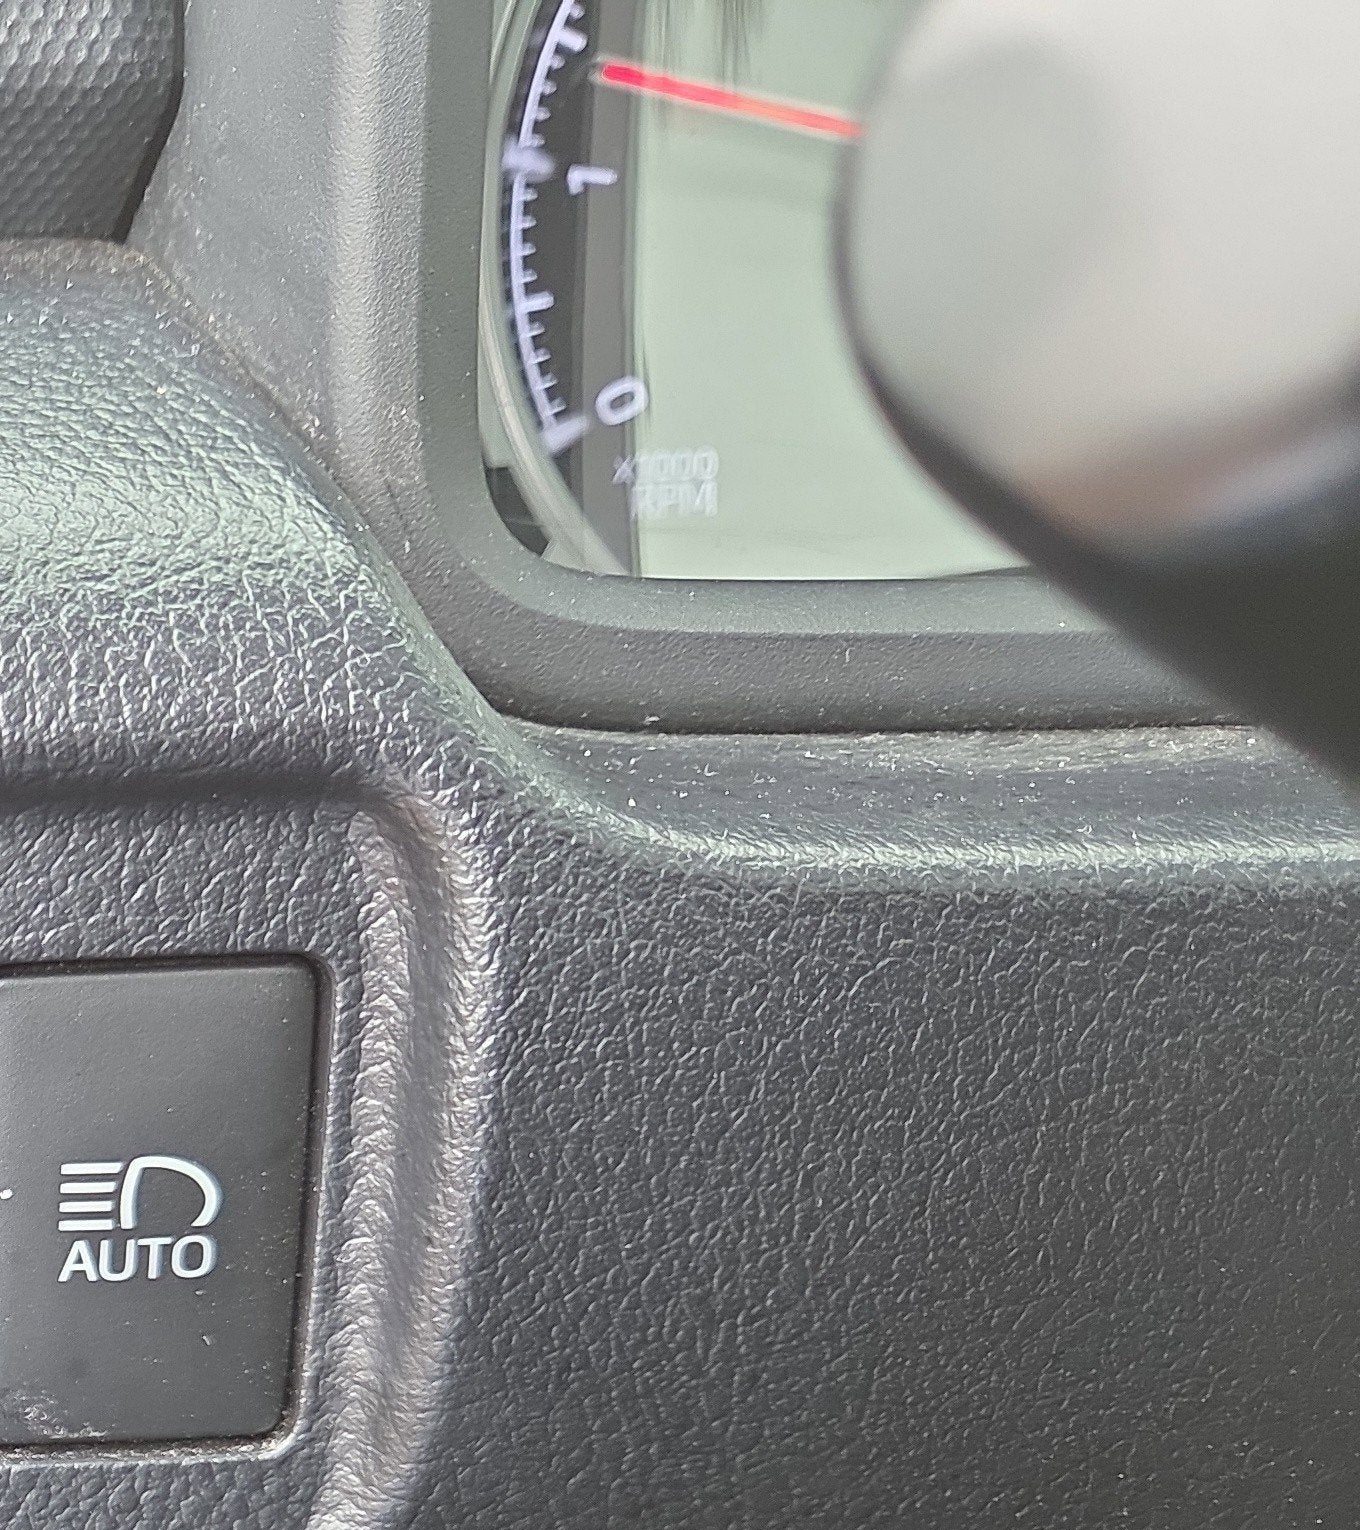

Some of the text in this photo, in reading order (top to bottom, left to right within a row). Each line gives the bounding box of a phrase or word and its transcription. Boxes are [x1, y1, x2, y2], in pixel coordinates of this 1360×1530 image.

[566, 163, 618, 196] 1
[595, 375, 649, 426] 0
[57, 1234, 218, 1283] AUTO
